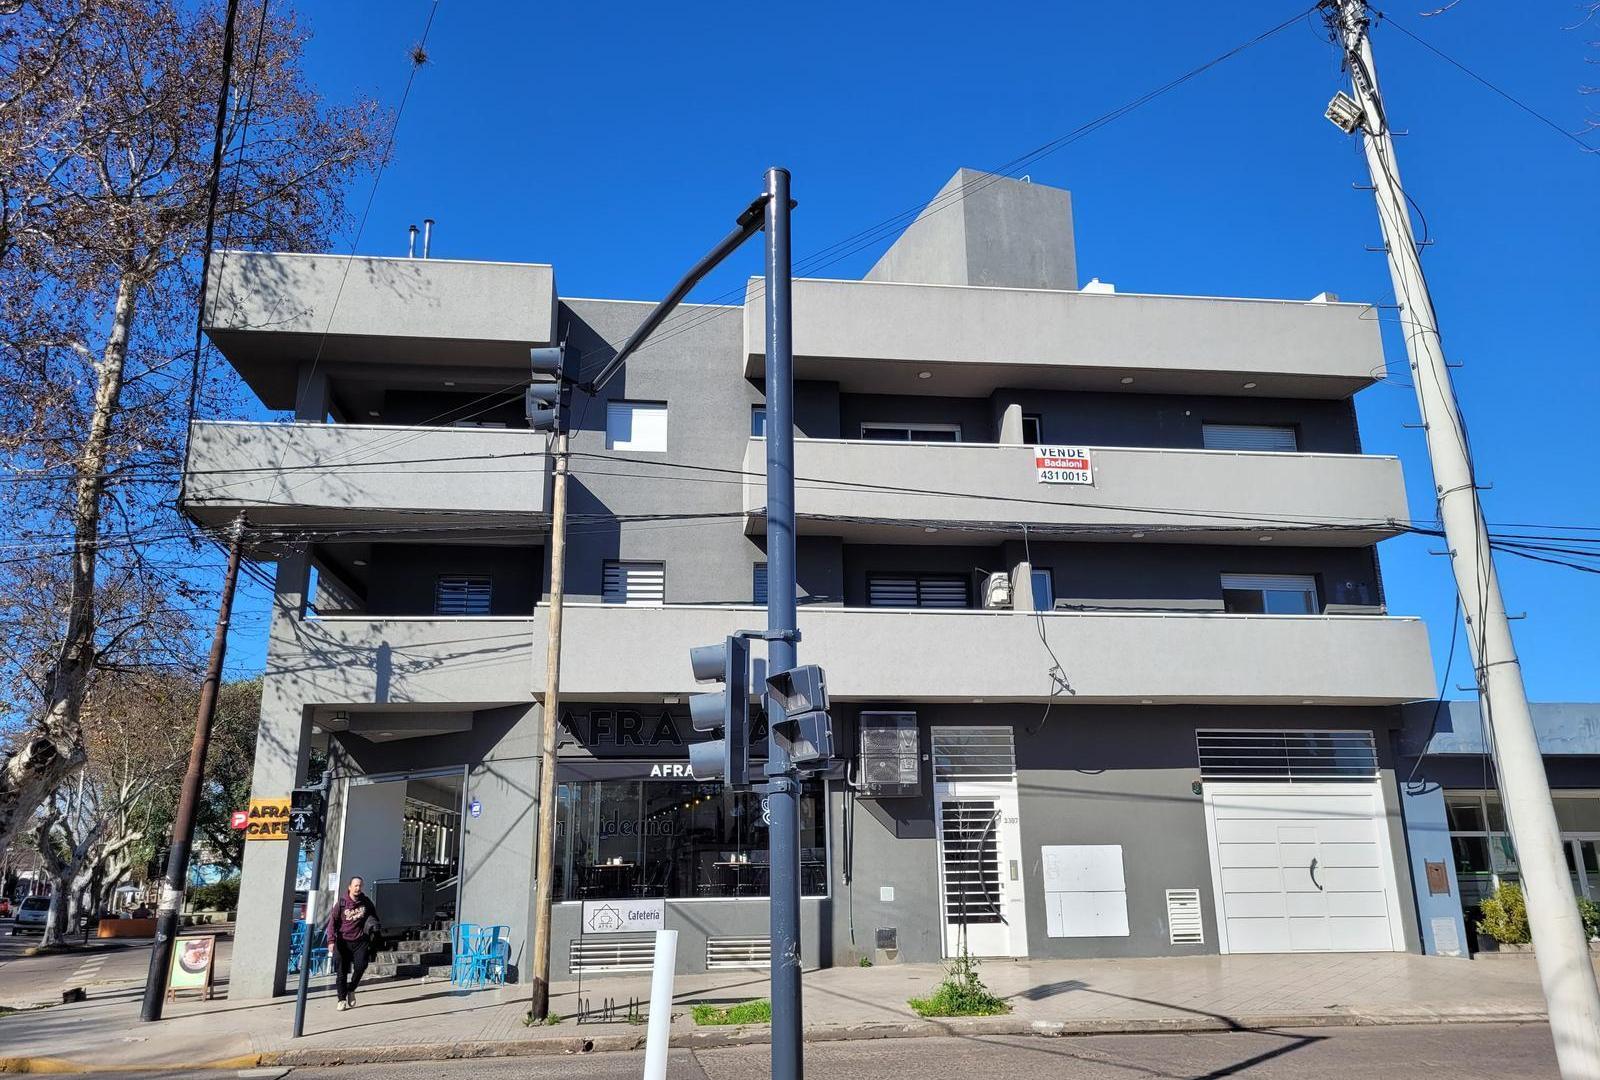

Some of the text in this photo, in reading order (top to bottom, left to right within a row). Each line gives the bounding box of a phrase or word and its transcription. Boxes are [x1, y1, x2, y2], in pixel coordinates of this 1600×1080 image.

[1040, 447, 1085, 458] VENDE
[1044, 459, 1083, 469] Badaloni
[556, 710, 683, 750] AFRA
[650, 764, 693, 777] AFRA
[249, 805, 290, 819] AFRA
[628, 909, 660, 921] Cafetería
